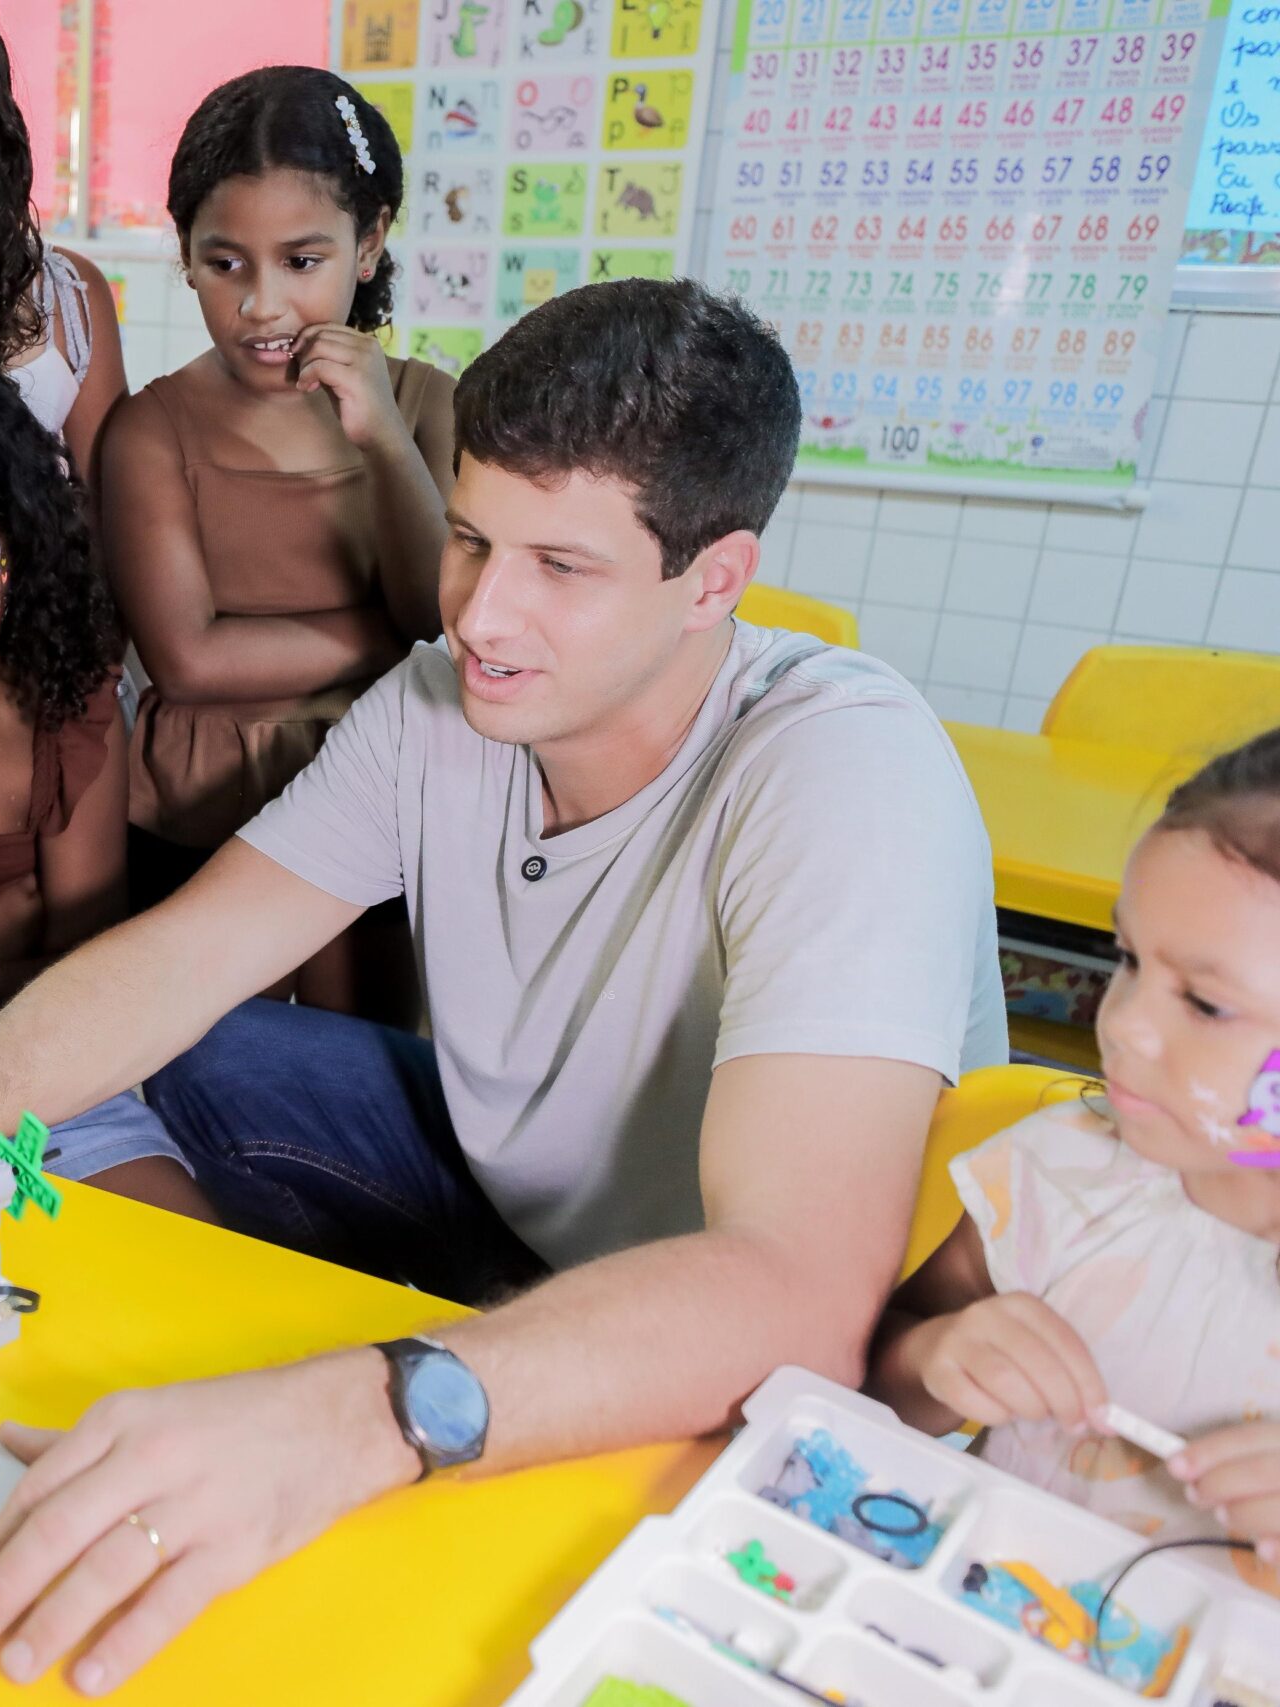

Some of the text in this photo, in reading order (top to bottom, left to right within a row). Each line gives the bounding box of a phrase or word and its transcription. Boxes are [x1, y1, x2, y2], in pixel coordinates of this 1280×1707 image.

[756, 0, 785, 25] 20
[750, 33, 1196, 79] 30 31 32 33 34 35 36 37 38 39
[516, 80, 539, 107] O
[612, 77, 629, 102] P
[743, 95, 1185, 134] 40 41 42 43 44 45 46 47 48 49
[424, 171, 440, 193] R
[512, 169, 528, 194] S
[605, 167, 622, 192] T
[736, 155, 1171, 187] 50 51 52 53 54 55 56 57 58 59
[730, 214, 1160, 241] 60 61 62 63 64 65 66 67 68 69
[594, 252, 612, 277] X
[765, 271, 789, 294] 71
[804, 271, 831, 295] 72
[846, 271, 873, 294] 73
[889, 272, 914, 296] 74
[931, 271, 959, 297] 75
[977, 273, 1003, 297] 76
[1025, 274, 1053, 298] 77
[1067, 274, 1096, 299] 78
[1118, 275, 1148, 300] 79
[796, 323, 823, 346] 82
[838, 324, 864, 347] 83
[880, 325, 908, 348] 84
[923, 326, 950, 350] 85
[965, 326, 993, 351] 86
[1011, 327, 1040, 353] 87
[1056, 328, 1086, 354] 88
[1103, 329, 1135, 355] 89
[831, 373, 857, 397] 93
[873, 375, 899, 398] 94
[914, 376, 943, 400] 95
[958, 378, 988, 401] 96
[1003, 380, 1033, 403] 97
[1048, 381, 1078, 406] 98
[1093, 383, 1123, 408] 99
[880, 424, 919, 452] 100
